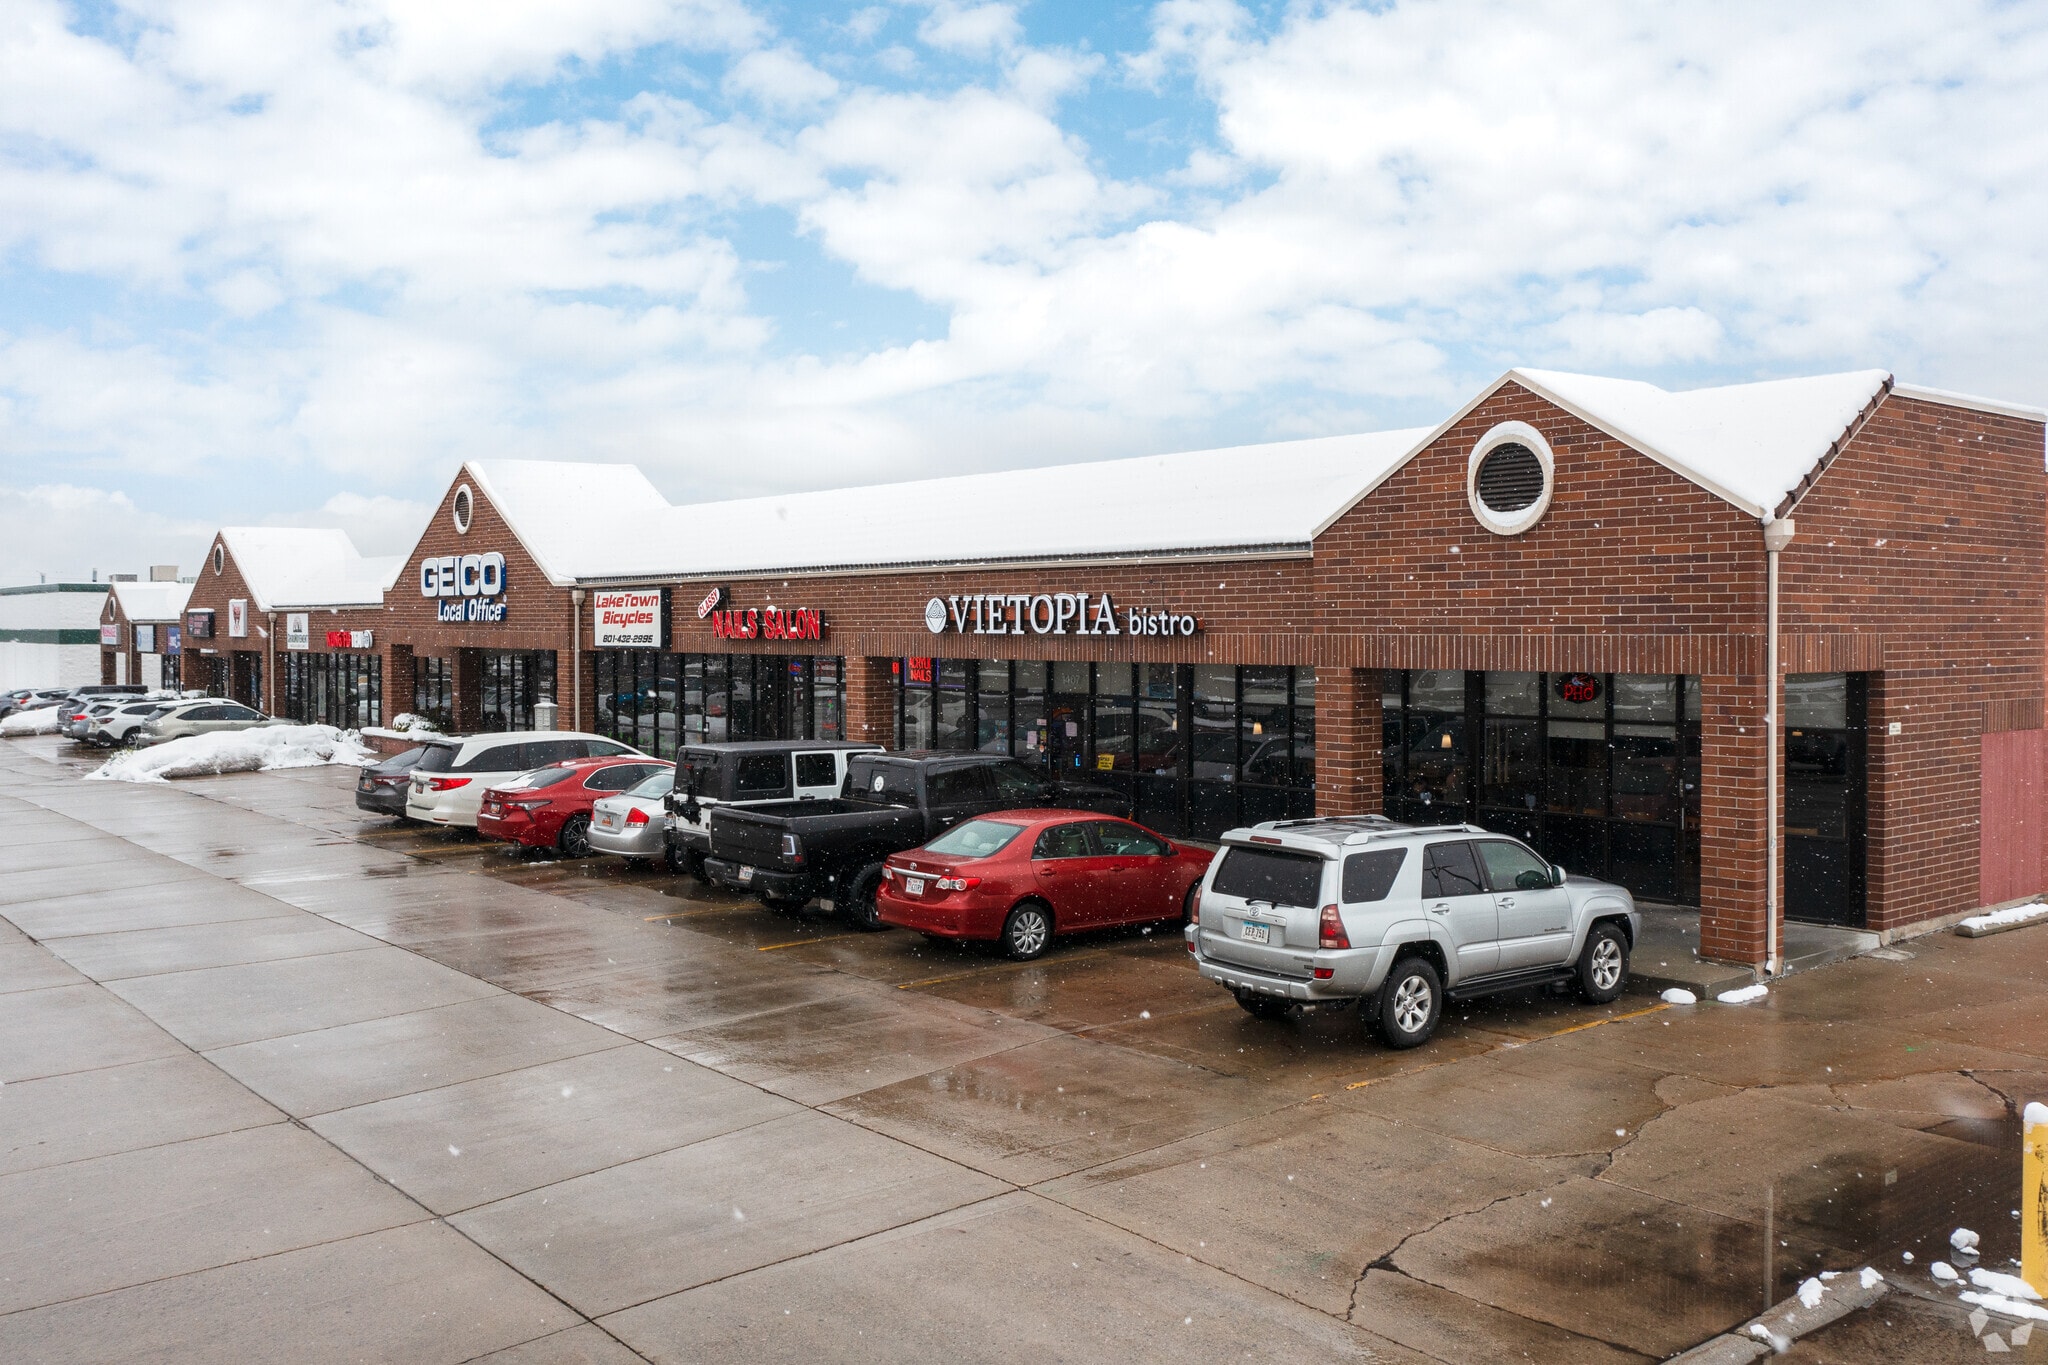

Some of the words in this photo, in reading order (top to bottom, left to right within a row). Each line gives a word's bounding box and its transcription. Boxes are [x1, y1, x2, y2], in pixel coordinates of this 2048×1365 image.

[420, 552, 506, 597] GEICO
[438, 599, 465, 621] Local
[468, 597, 502, 622] Office
[596, 593, 659, 608] LakeTown
[699, 589, 718, 616] CLASSY
[602, 610, 654, 628] Bicycles
[713, 609, 758, 639] NAILS
[764, 609, 820, 639] SALON
[949, 593, 1119, 635] VIETOPIA
[1129, 607, 1195, 636] bistro
[602, 634, 654, 643] 801-432-2995
[910, 669, 932, 682] NAILS
